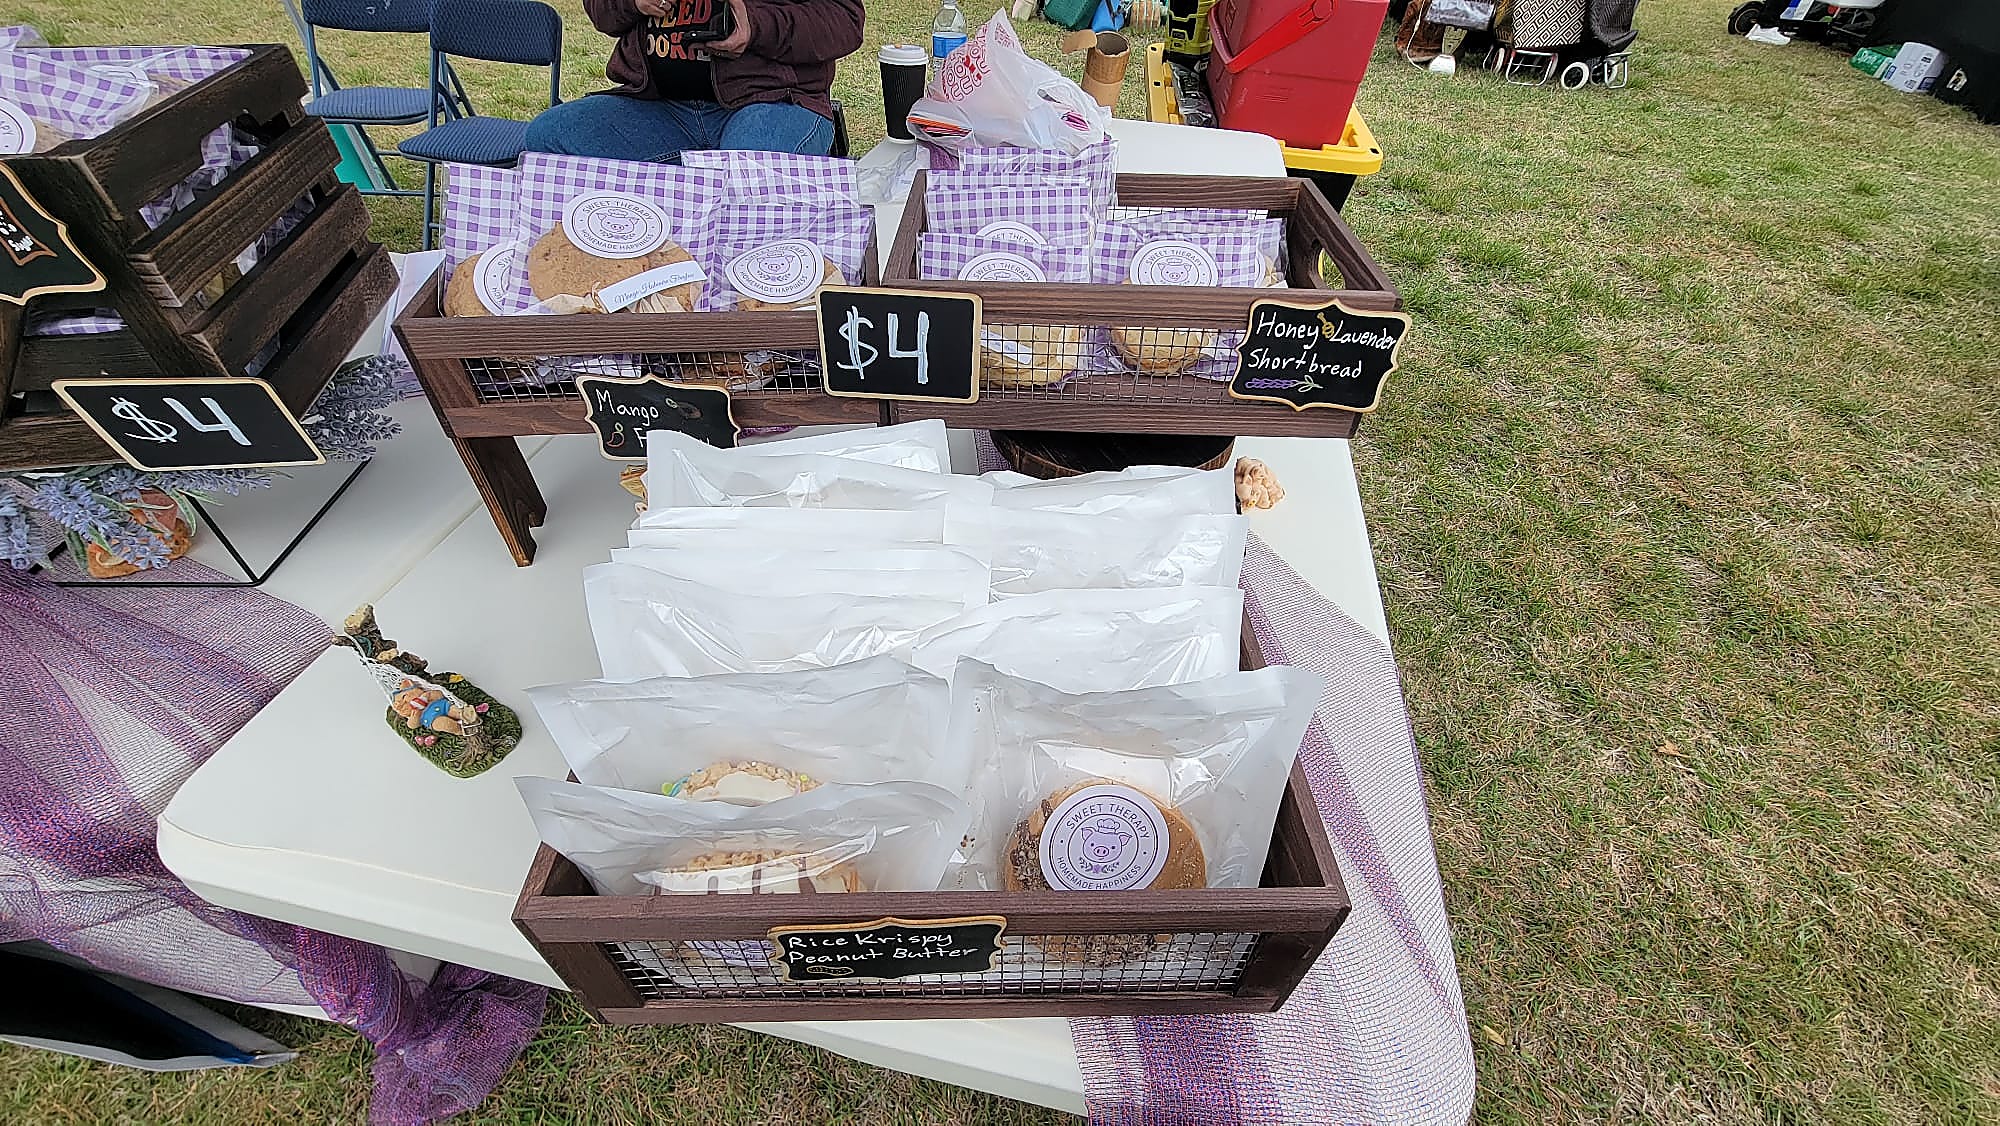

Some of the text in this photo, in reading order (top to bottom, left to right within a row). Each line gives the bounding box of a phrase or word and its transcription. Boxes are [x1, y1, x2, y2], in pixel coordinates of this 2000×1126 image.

[582, 200, 654, 221] SWEET THERAPY
[580, 229, 655, 251] HOMEMADE HAPPINESS
[972, 262, 1033, 281] SWEET THERAPY
[1145, 249, 1203, 266] SWEET THERAPY
[740, 270, 809, 294] HOMEMADE HAPPINESS
[1255, 311, 1397, 350] Honey Lavender
[836, 305, 930, 385] $4
[1247, 347, 1363, 379] Shortbread
[110, 396, 252, 446] $4
[595, 388, 660, 427] Mango
[1066, 803, 1150, 840] SWEET THERAPY
[1056, 855, 1142, 890] HOMEMADE HAPPINESS
[788, 933, 954, 949] Rice Krispy
[788, 949, 884, 965] Peanut
[892, 947, 979, 960] Butter
